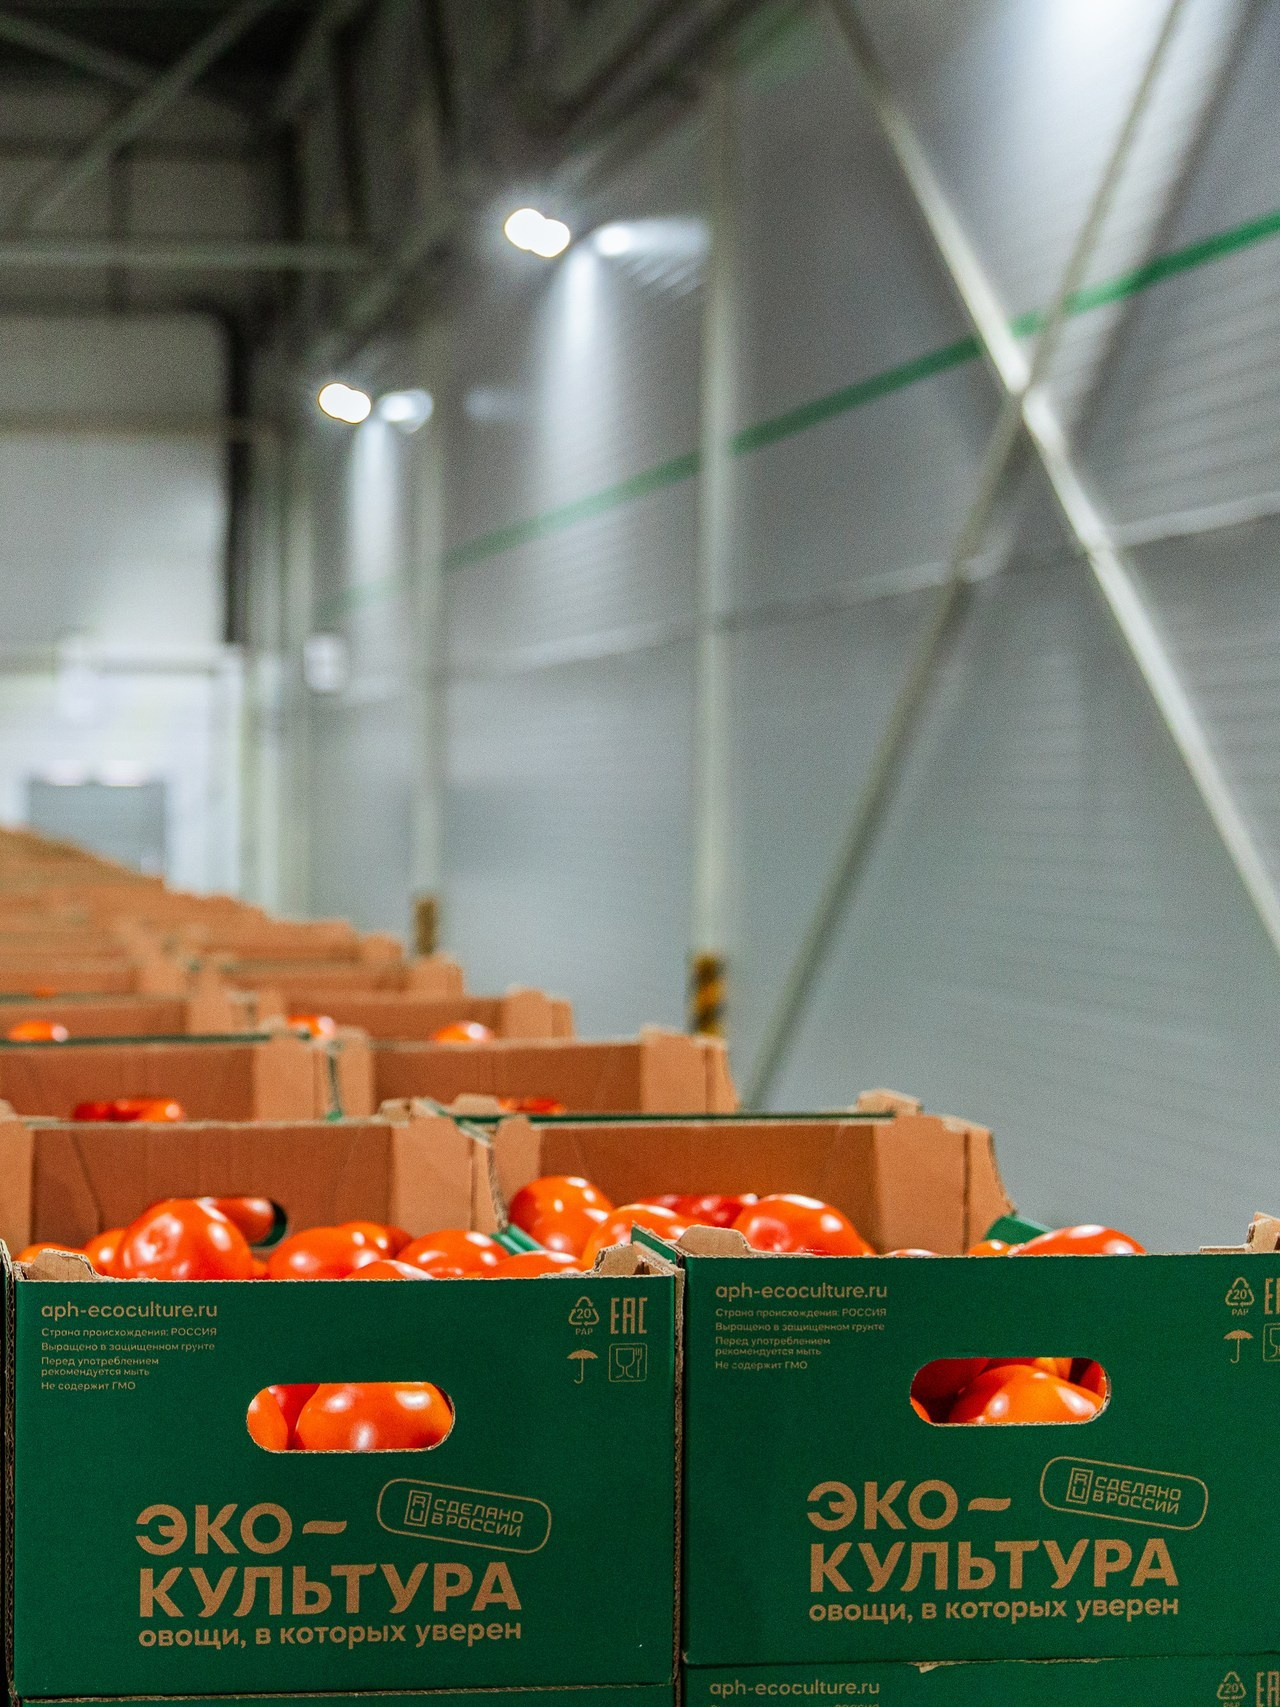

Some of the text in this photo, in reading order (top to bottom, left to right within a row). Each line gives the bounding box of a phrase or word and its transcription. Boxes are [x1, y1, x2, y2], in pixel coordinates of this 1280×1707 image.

[716, 1282, 887, 1302] aph-ecoculture.ru
[1232, 1289, 1247, 1300] 20
[41, 1301, 217, 1321] aph-ecoculture.ru
[576, 1308, 591, 1319] 20
[715, 1308, 754, 1318] Страна
[842, 1308, 886, 1317] РОССИЯ
[41, 1327, 217, 1338] Страна происхождения: РОССИЯ
[575, 1327, 593, 1336] PAP
[715, 1322, 771, 1332] Выращено
[782, 1323, 850, 1332] защищенном
[852, 1324, 884, 1333] грунте
[715, 1336, 830, 1346] Перед употреблением
[41, 1342, 98, 1351] Выращено
[110, 1343, 178, 1352] защищенном
[181, 1344, 215, 1353] грунте
[796, 1348, 821, 1356] мыть
[41, 1356, 159, 1367] Перед употреблением
[715, 1361, 808, 1371] Не содержит ГМО
[41, 1368, 149, 1378] рекомендуется мыть
[41, 1381, 136, 1392] Не содержит ГМО
[1095, 1476, 1181, 1500] СДЕЛАНО
[434, 1499, 523, 1523] СДЕЛАНО
[811, 1538, 1178, 1592] КУЛЬТУРА
[140, 1562, 521, 1617] КУЛЬТУРА
[809, 1598, 1178, 1624] овощи, в которых уверен
[139, 1623, 521, 1650] овощи, в которых уверен
[710, 1679, 880, 1698] aph-ecoculture.ru
